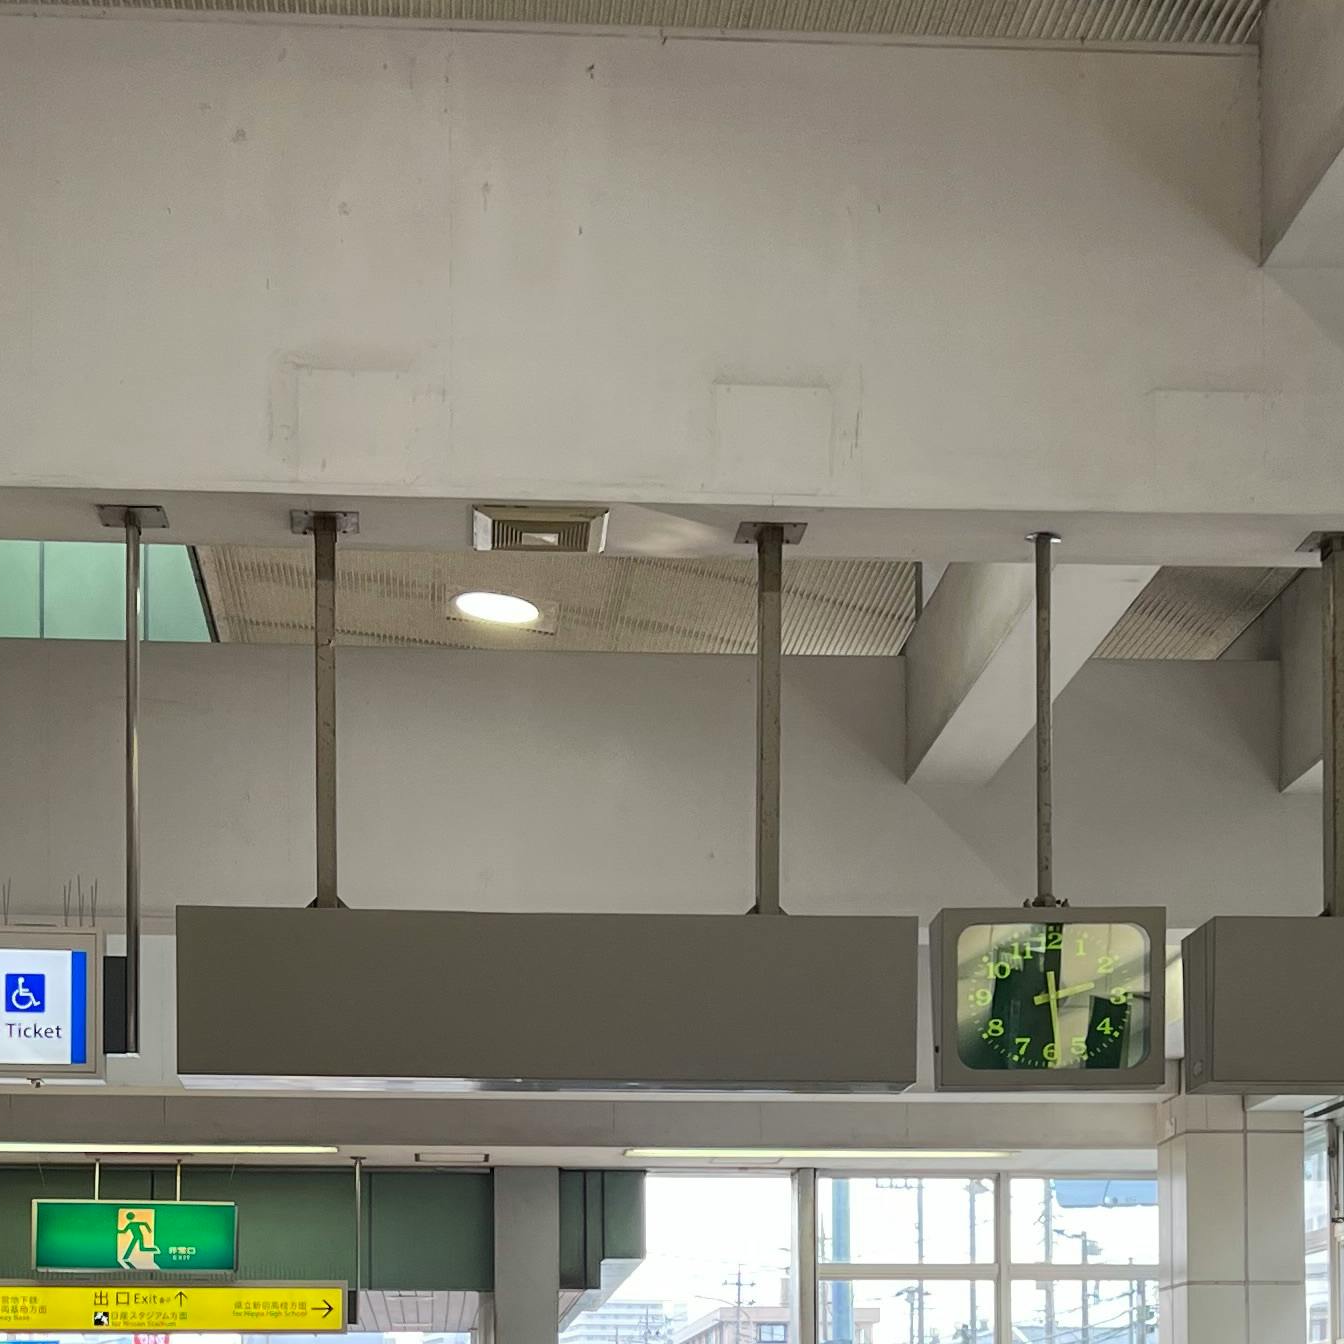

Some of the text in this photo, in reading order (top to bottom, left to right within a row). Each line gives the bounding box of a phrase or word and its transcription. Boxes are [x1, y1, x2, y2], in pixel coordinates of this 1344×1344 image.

[1011, 942, 1034, 960] 11
[1075, 938, 1087, 956] 1
[986, 961, 1011, 979] 10
[1097, 956, 1115, 975] 2
[975, 988, 993, 1007] 9
[1109, 986, 1127, 1005] 3
[6, 1023, 63, 1040] Ticket
[987, 1018, 1004, 1037] 8
[1096, 1017, 1114, 1035] 4
[1014, 1037, 1031, 1055] 7
[1042, 1043, 1058, 1061] 6
[1071, 1037, 1087, 1055] 5
[93, 1290, 130, 1306] 出口
[134, 1293, 158, 1305] Exit
